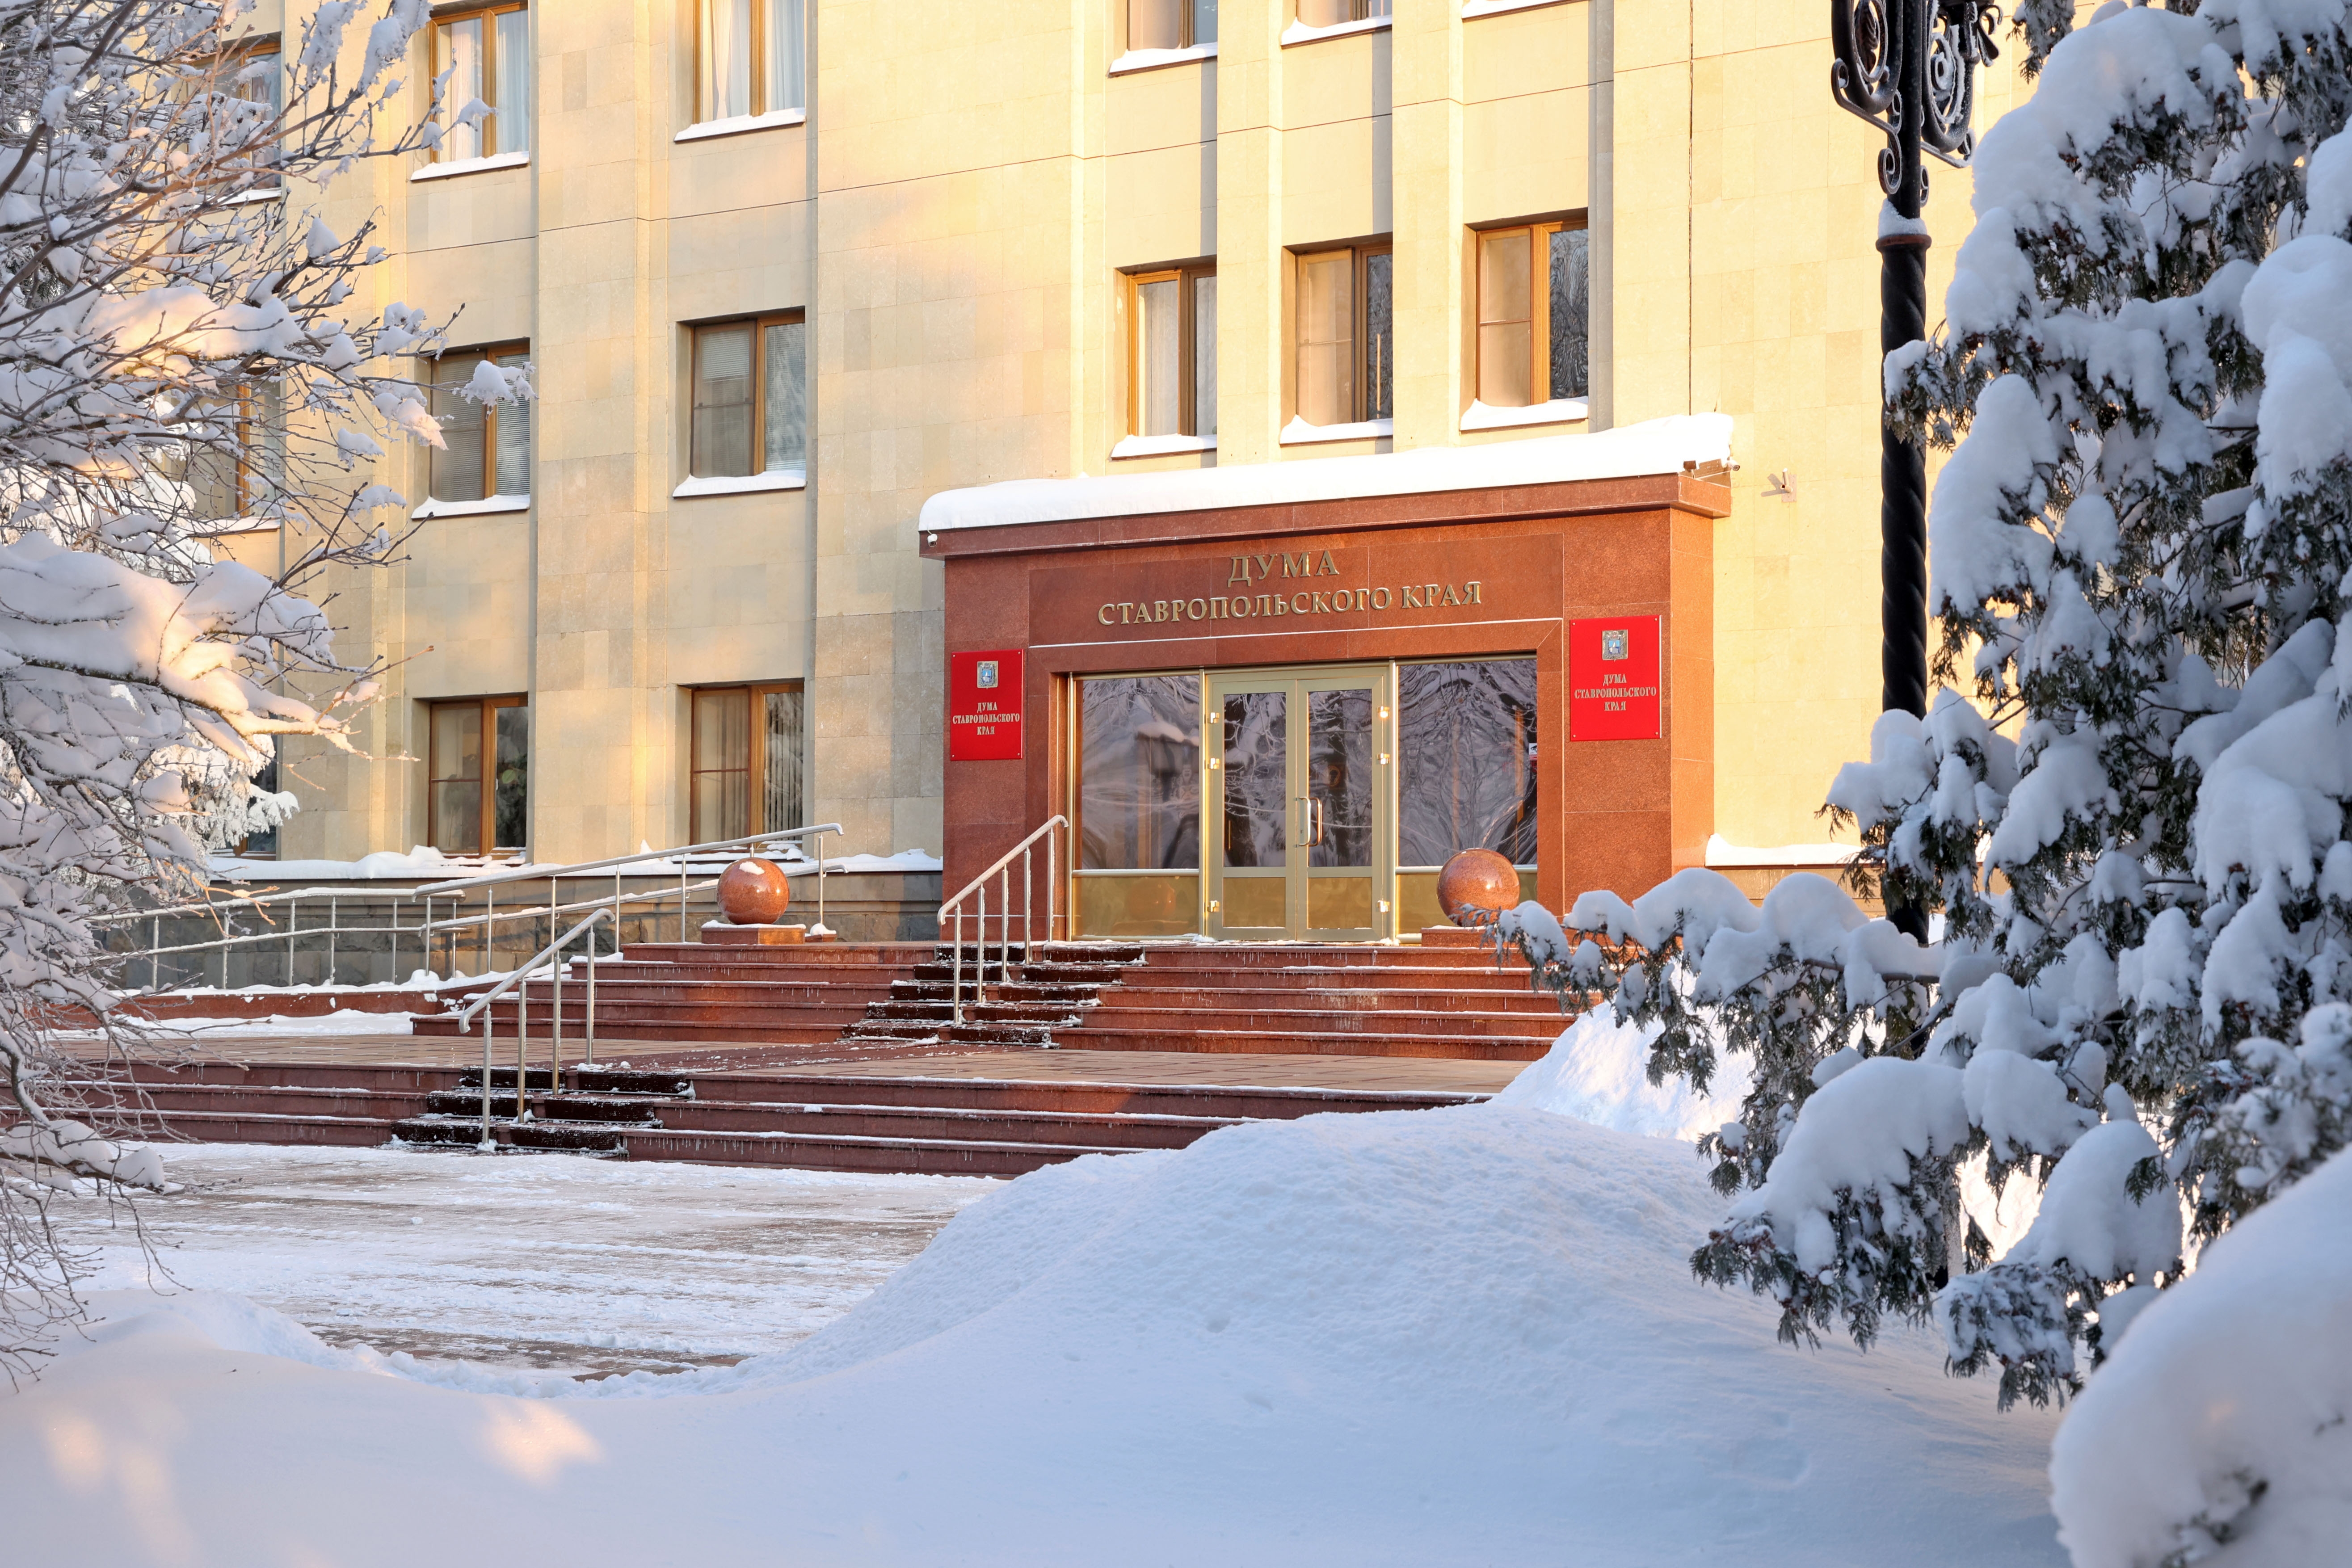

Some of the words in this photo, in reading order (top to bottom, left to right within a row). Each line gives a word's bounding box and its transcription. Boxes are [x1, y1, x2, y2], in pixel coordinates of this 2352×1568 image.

[1228, 550, 1340, 588] ДУМА
[1098, 587, 1392, 625] СТАВРОПОЛЬСКОГО
[1402, 581, 1481, 609] КРАЯ
[1603, 673, 1627, 686] ДУМА
[1574, 686, 1657, 699] СТАВРОПОЛЬСКОГО
[977, 702, 997, 713] ДУМА
[1604, 701, 1626, 711] КРАЯ
[952, 713, 1020, 724] СТАВРОПОЛЬСКОГО
[977, 726, 995, 735] КРАЯ
